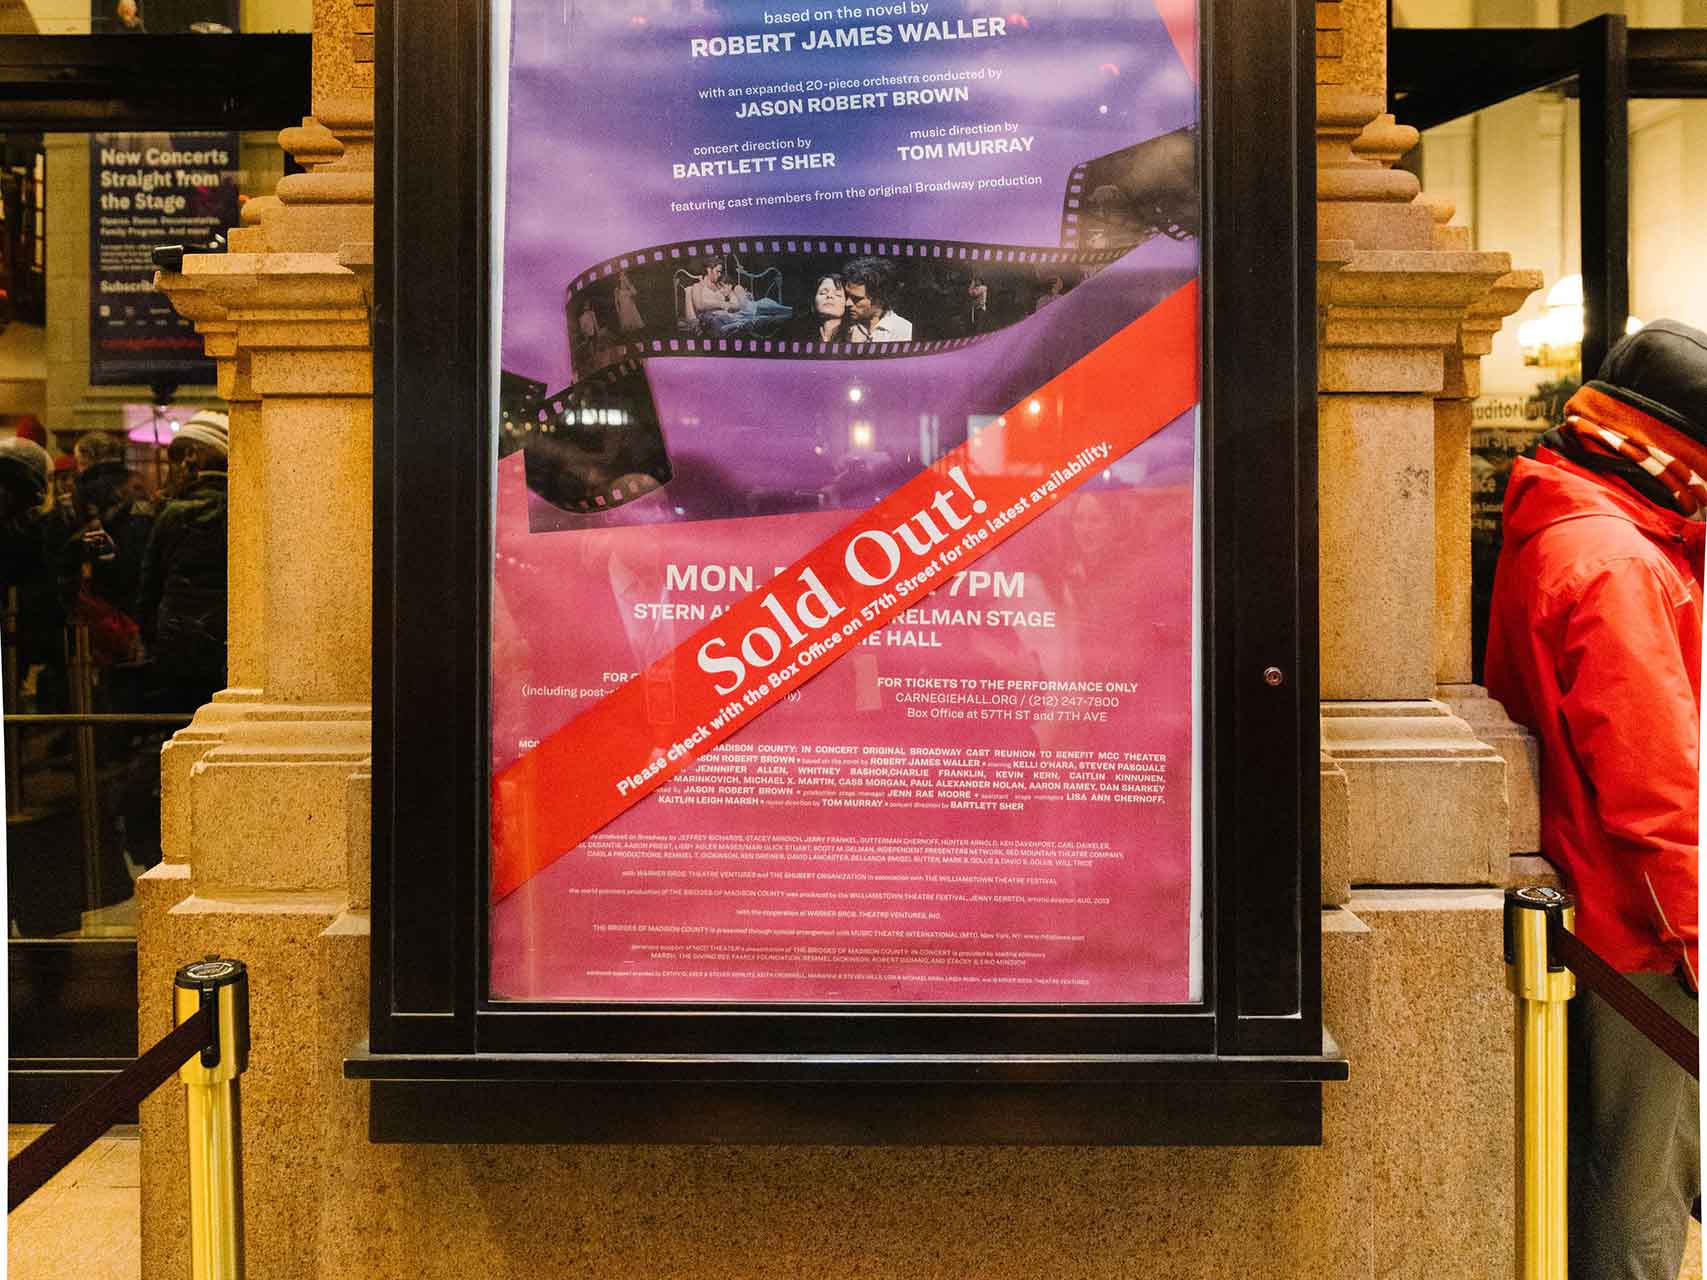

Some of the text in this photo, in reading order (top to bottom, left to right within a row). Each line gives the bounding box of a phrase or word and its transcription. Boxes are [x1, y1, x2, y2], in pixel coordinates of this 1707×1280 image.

[764, 1, 929, 24] based on the novel by
[690, 17, 1007, 58] ROBERT JAMES WALLER
[698, 68, 1002, 99] with an expanded 20-piece orchestra conducted by
[735, 87, 969, 119] JASON ROBERT BROWN
[910, 122, 1018, 139] music direction by
[102, 148, 228, 165] New Concerts
[693, 138, 811, 156] concert direction by
[898, 137, 1034, 161] TOM MURRAY
[672, 153, 836, 179] BARTLETT SHER
[101, 170, 219, 191] Straight from
[101, 193, 186, 213] the Stage
[671, 174, 1042, 213] featuring cast members from the original Broadway production
[697, 466, 987, 696] Sold Out!
[948, 571, 1024, 598] 7PM
[616, 755, 668, 797] Please
[667, 725, 712, 761] check
[710, 701, 745, 731] with
[743, 683, 770, 706] the
[768, 663, 800, 688] Box
[798, 632, 842, 667] Office
[842, 617, 863, 635] on
[860, 593, 898, 622] 57th
[895, 560, 941, 597] Street
[939, 545, 963, 567] for
[962, 528, 988, 551] the
[987, 497, 1031, 534] latest
[1029, 440, 1114, 504] availability.
[633, 604, 704, 620] STERN
[986, 610, 1056, 628] STAGE
[887, 631, 942, 648] HALL
[603, 672, 628, 682] FOR
[877, 677, 1138, 693] FOR TICKETS TO THE PERFORMANCE ONLY
[521, 685, 577, 698] (including
[895, 692, 1119, 708] CARNEGIEHALL.ORG / (212) 247-7800
[907, 708, 1107, 721] Box Office at 57TH ST and 7TH AVE
[713, 744, 753, 753] ADISON
[802, 745, 811, 753] IN
[816, 746, 858, 754] CONCERT
[863, 746, 905, 755] ORIGINAL
[910, 747, 962, 756] BROADWAY
[994, 750, 1036, 758] REUNION
[1056, 751, 1094, 759] BENEFIT
[1098, 752, 1120, 760] MCC
[1124, 752, 1166, 762] THEATER
[721, 755, 758, 763] ROBERT
[761, 756, 795, 764] BROWN
[870, 757, 907, 766] ROBERT
[908, 758, 940, 766] JAMES
[942, 759, 980, 767] WALLER
[1013, 761, 1038, 769] KELLI
[1079, 762, 1116, 770] STEVEN
[1118, 763, 1166, 773] PASQUALE
[683, 786, 714, 794] JASON
[718, 786, 754, 795] ROBERT
[759, 787, 793, 795] BROWN
[1067, 793, 1087, 801] LISA
[1090, 794, 1111, 802] ANN
[725, 797, 759, 805] MARSH
[844, 799, 883, 808] MURRAY
[951, 801, 997, 810] BARTLETT
[999, 803, 1024, 811] SHER
